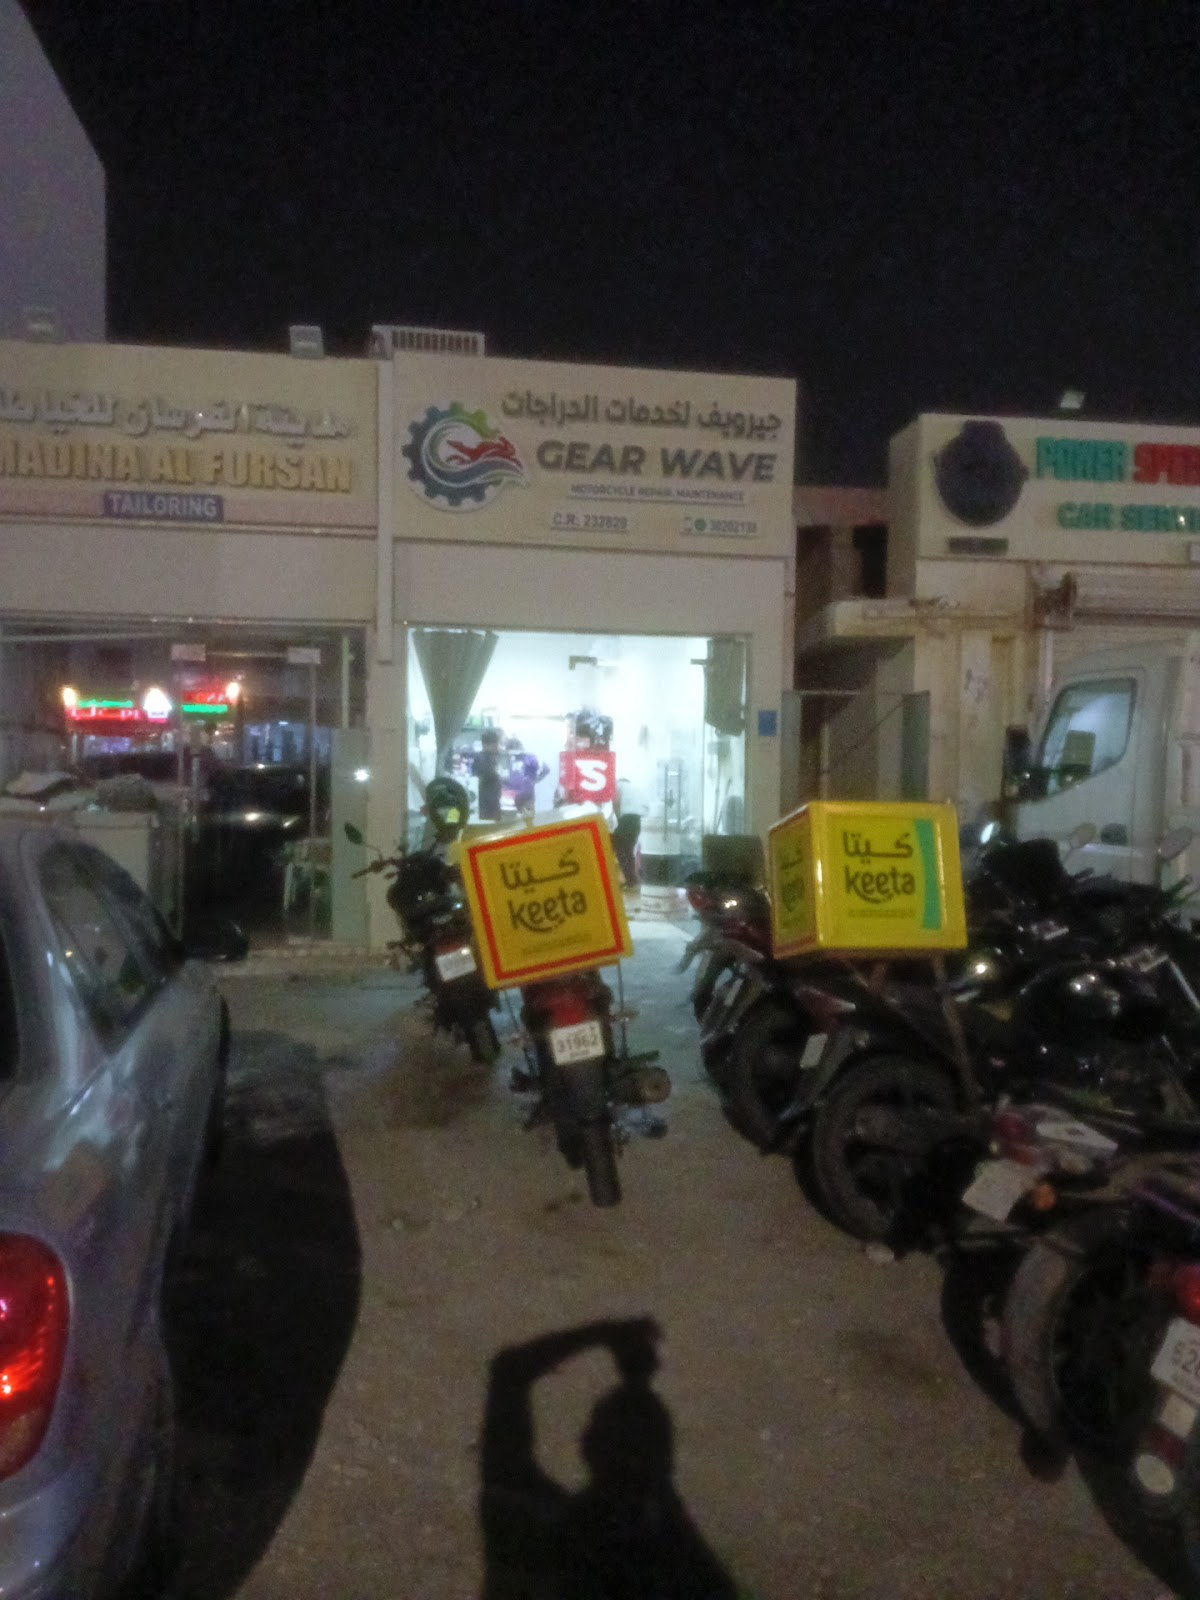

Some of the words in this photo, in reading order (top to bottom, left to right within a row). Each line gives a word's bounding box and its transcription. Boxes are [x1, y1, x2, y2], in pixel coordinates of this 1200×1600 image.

[501, 390, 598, 428] الدراجات
[605, 397, 690, 428] لخدمات
[152, 446, 195, 485] AL
[203, 450, 351, 493] FURSAN
[537, 440, 646, 476] GEAR
[660, 447, 777, 483] WAVE
[109, 494, 217, 518] TAILORING
[571, 483, 635, 497] MOTORCYCLE
[843, 831, 914, 864] كيتا
[500, 848, 580, 893] كيتا
[845, 864, 916, 904] keeta
[508, 888, 588, 933] keeta
